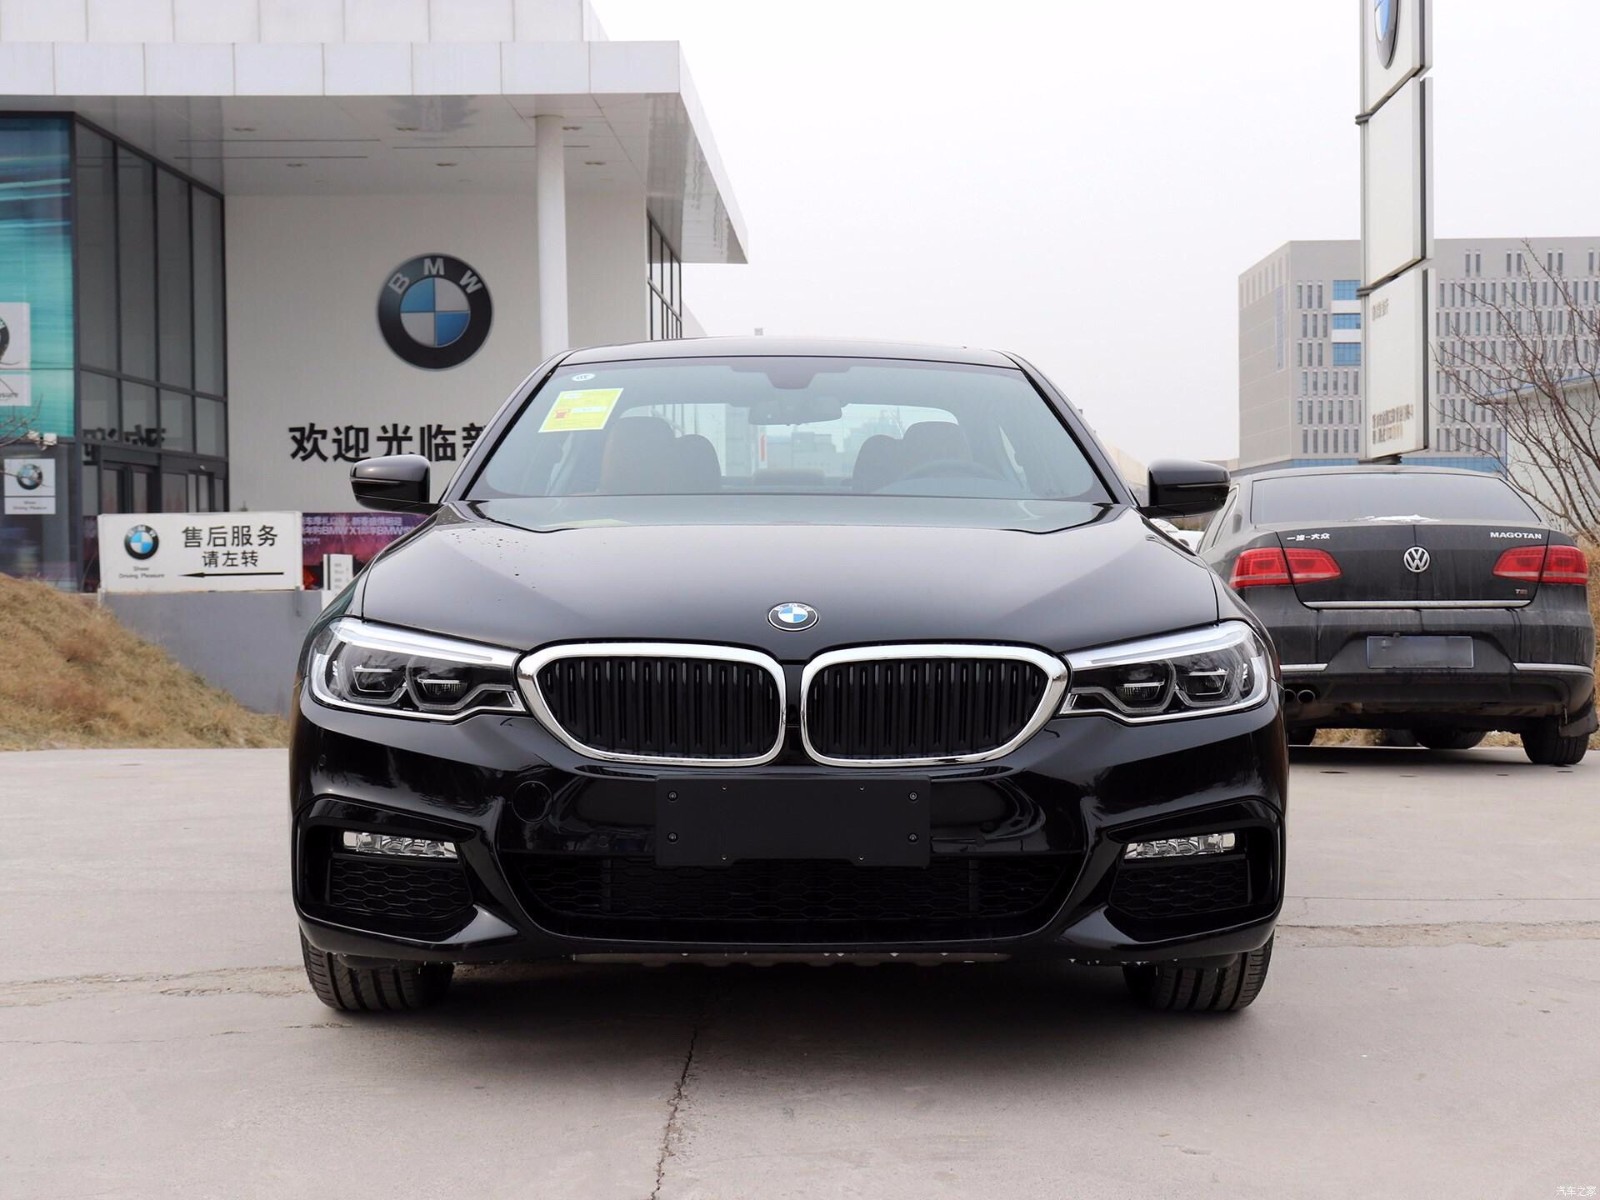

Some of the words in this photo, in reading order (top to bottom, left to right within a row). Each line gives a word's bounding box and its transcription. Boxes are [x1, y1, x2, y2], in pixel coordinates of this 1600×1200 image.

[388, 258, 482, 294] BMW
[182, 525, 278, 548] 售后服务
[202, 551, 258, 568] 请左转
